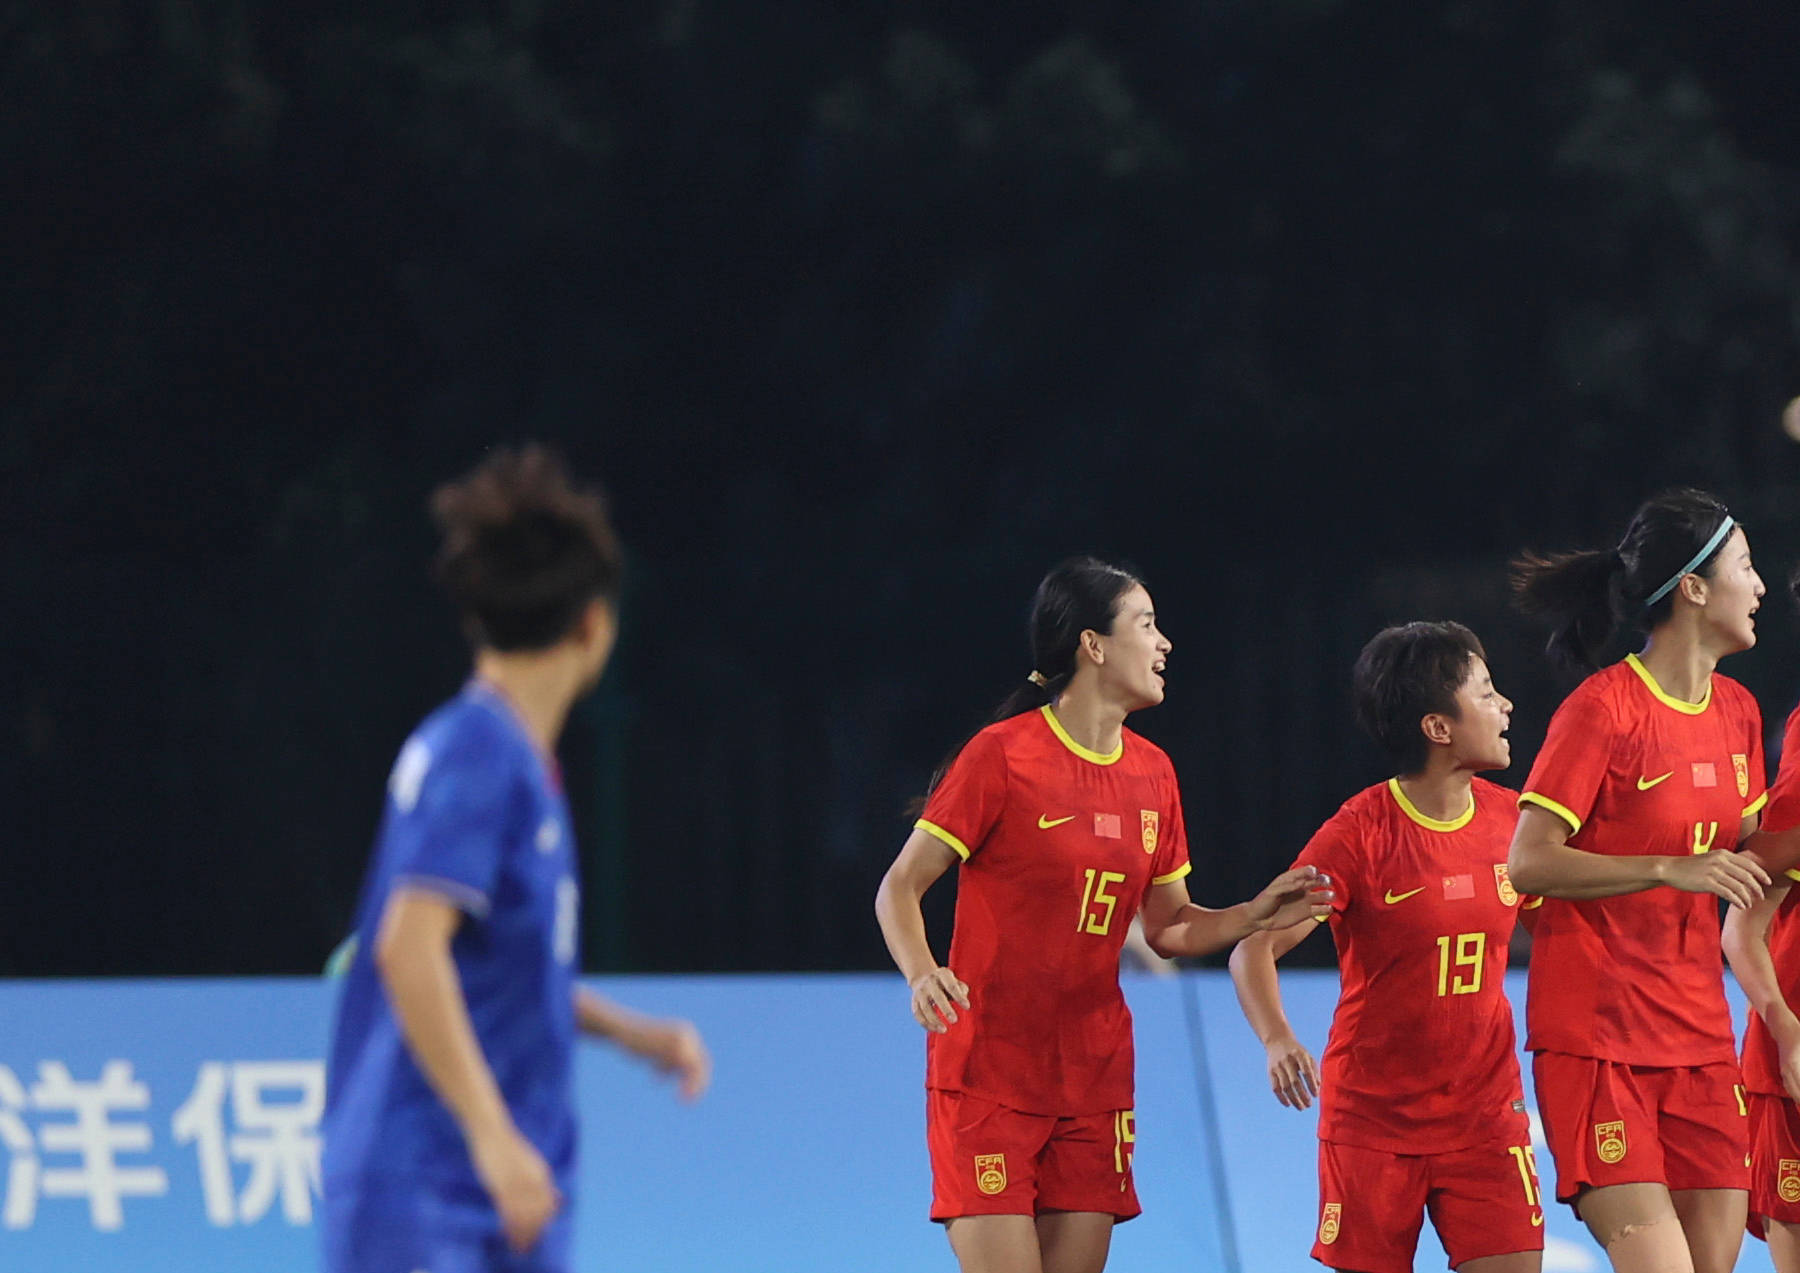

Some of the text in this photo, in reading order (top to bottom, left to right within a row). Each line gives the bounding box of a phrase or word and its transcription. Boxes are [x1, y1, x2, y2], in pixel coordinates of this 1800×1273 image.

[1077, 868, 1126, 936] 15
[1437, 932, 1485, 997] 19
[0, 1060, 325, 1231] 洋保
